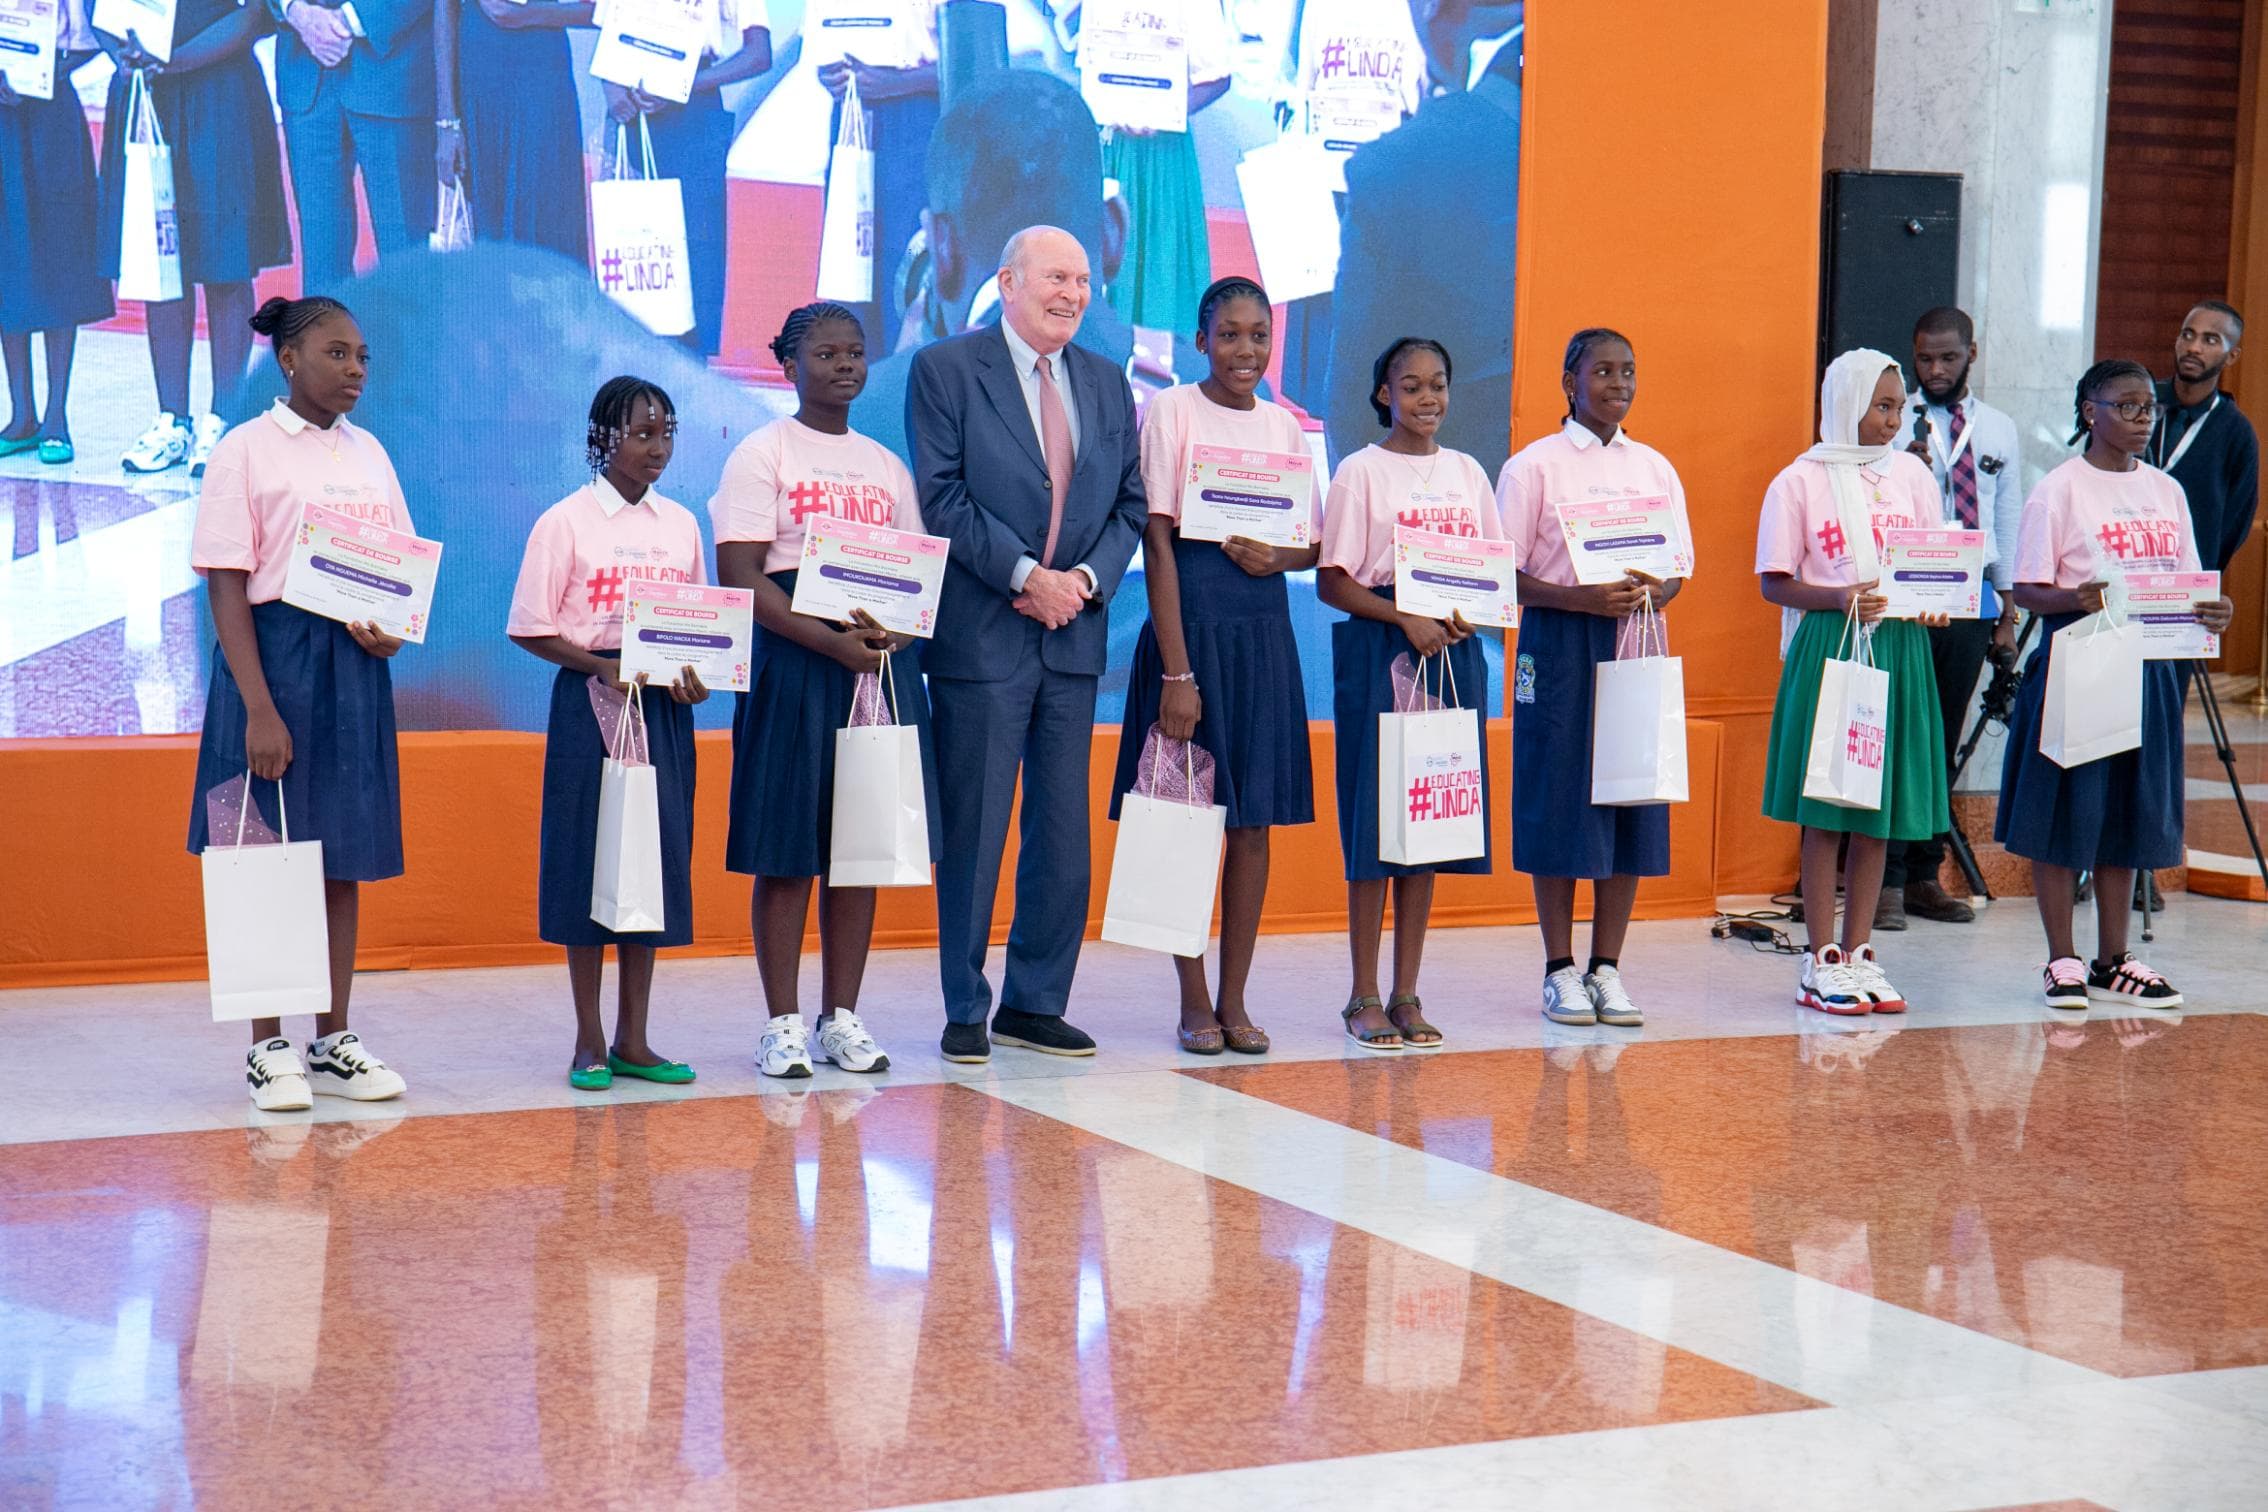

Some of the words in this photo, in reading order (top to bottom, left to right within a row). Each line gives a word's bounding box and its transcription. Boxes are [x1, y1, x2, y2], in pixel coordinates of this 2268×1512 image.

[625, 262, 676, 291] LINDA
[824, 481, 895, 506] EDUCATING
[842, 546, 876, 558] CERTIFICAT
[655, 607, 685, 617] CERTIFICAT
[1431, 769, 1480, 789] EDUCATING
[1432, 787, 1481, 820] LINDA
